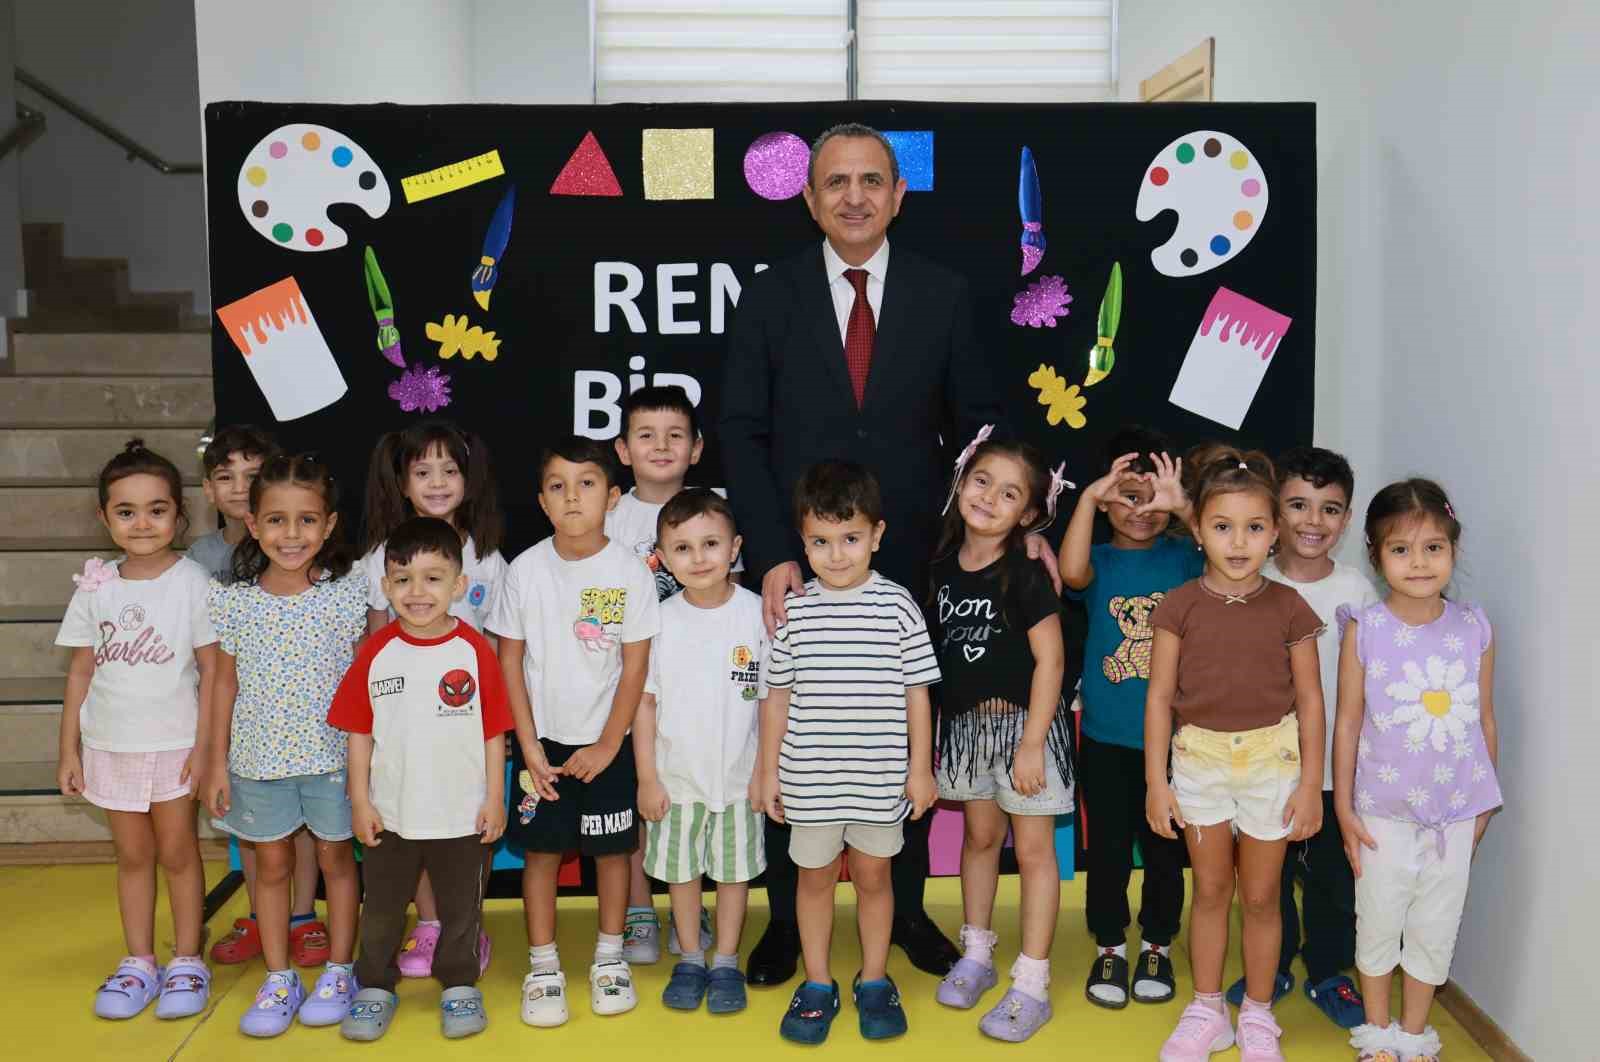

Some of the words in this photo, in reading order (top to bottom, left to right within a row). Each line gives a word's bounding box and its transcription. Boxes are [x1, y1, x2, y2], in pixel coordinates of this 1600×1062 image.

[937, 584, 998, 624] Bon
[95, 621, 175, 666] Barbie
[371, 676, 404, 698] MARVEL
[604, 808, 633, 835] MARIO
